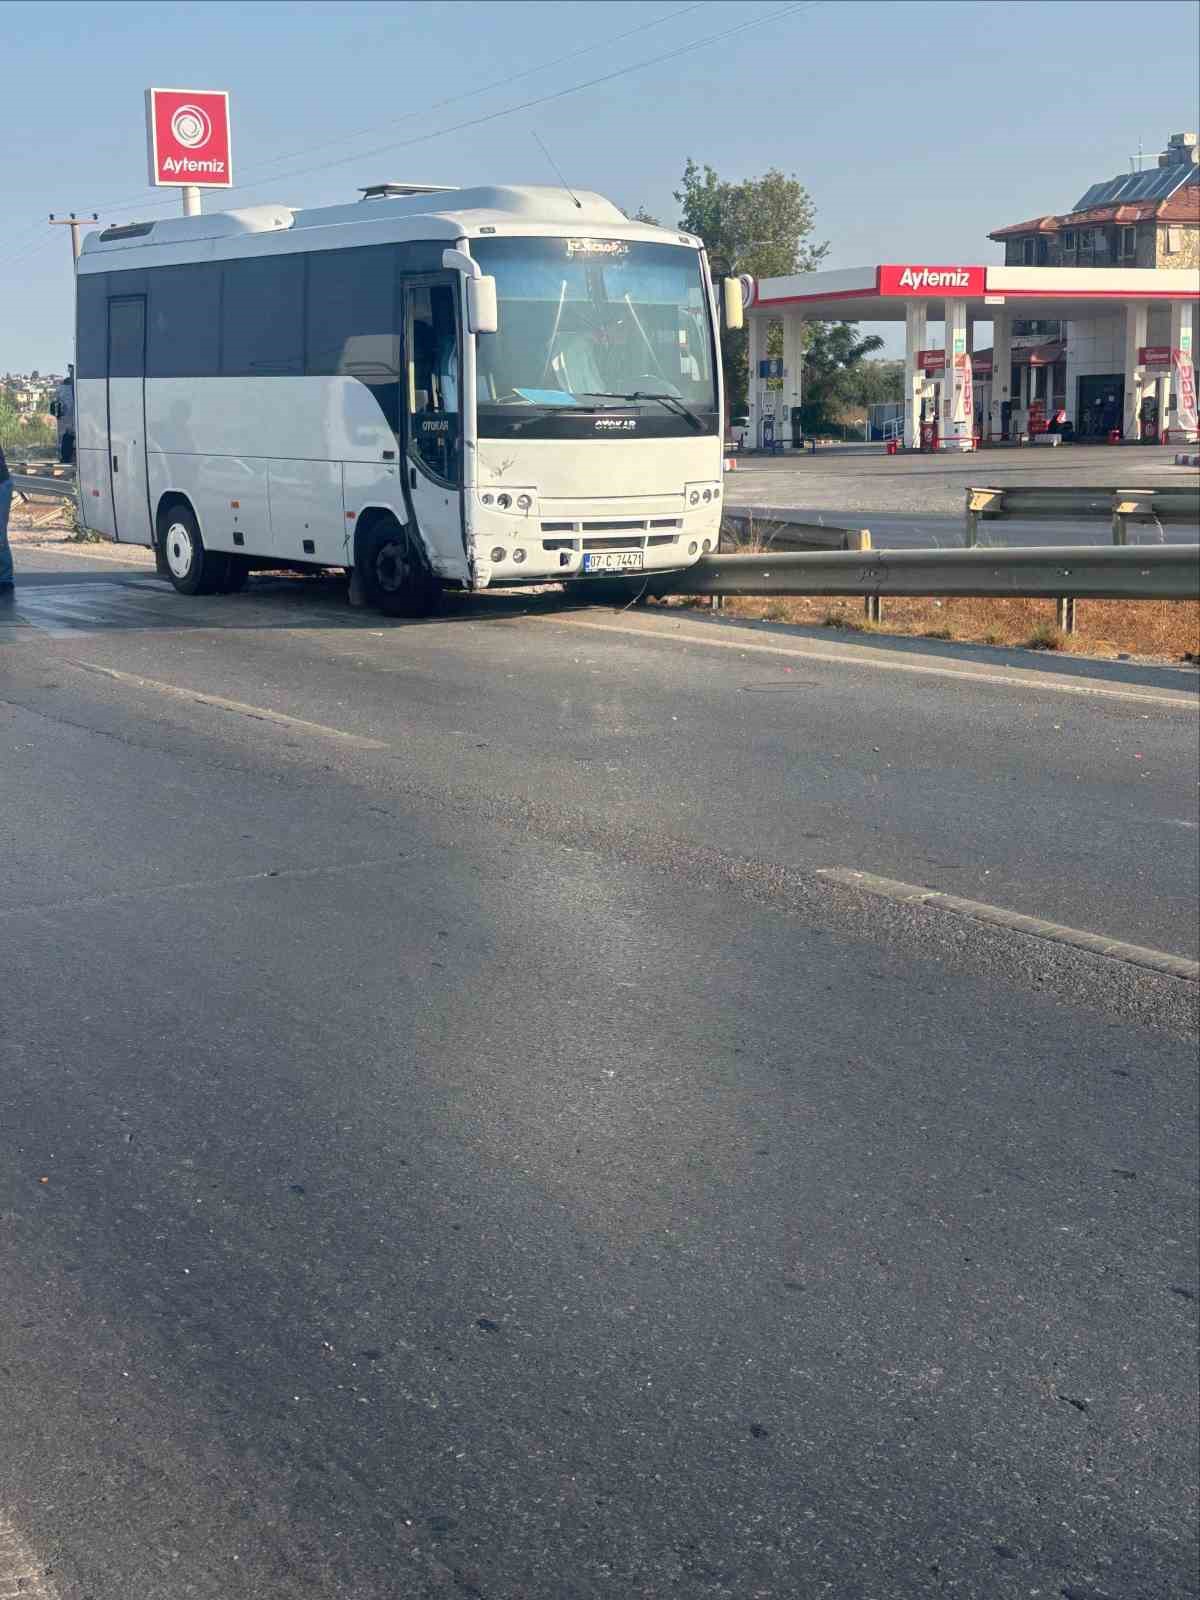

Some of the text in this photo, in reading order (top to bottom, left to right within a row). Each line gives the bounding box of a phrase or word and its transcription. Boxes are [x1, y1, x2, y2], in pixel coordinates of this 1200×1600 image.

[163, 157, 225, 174] Aytemiz
[899, 268, 970, 290] Aytemiz
[591, 553, 641, 567] 07 C 74471
